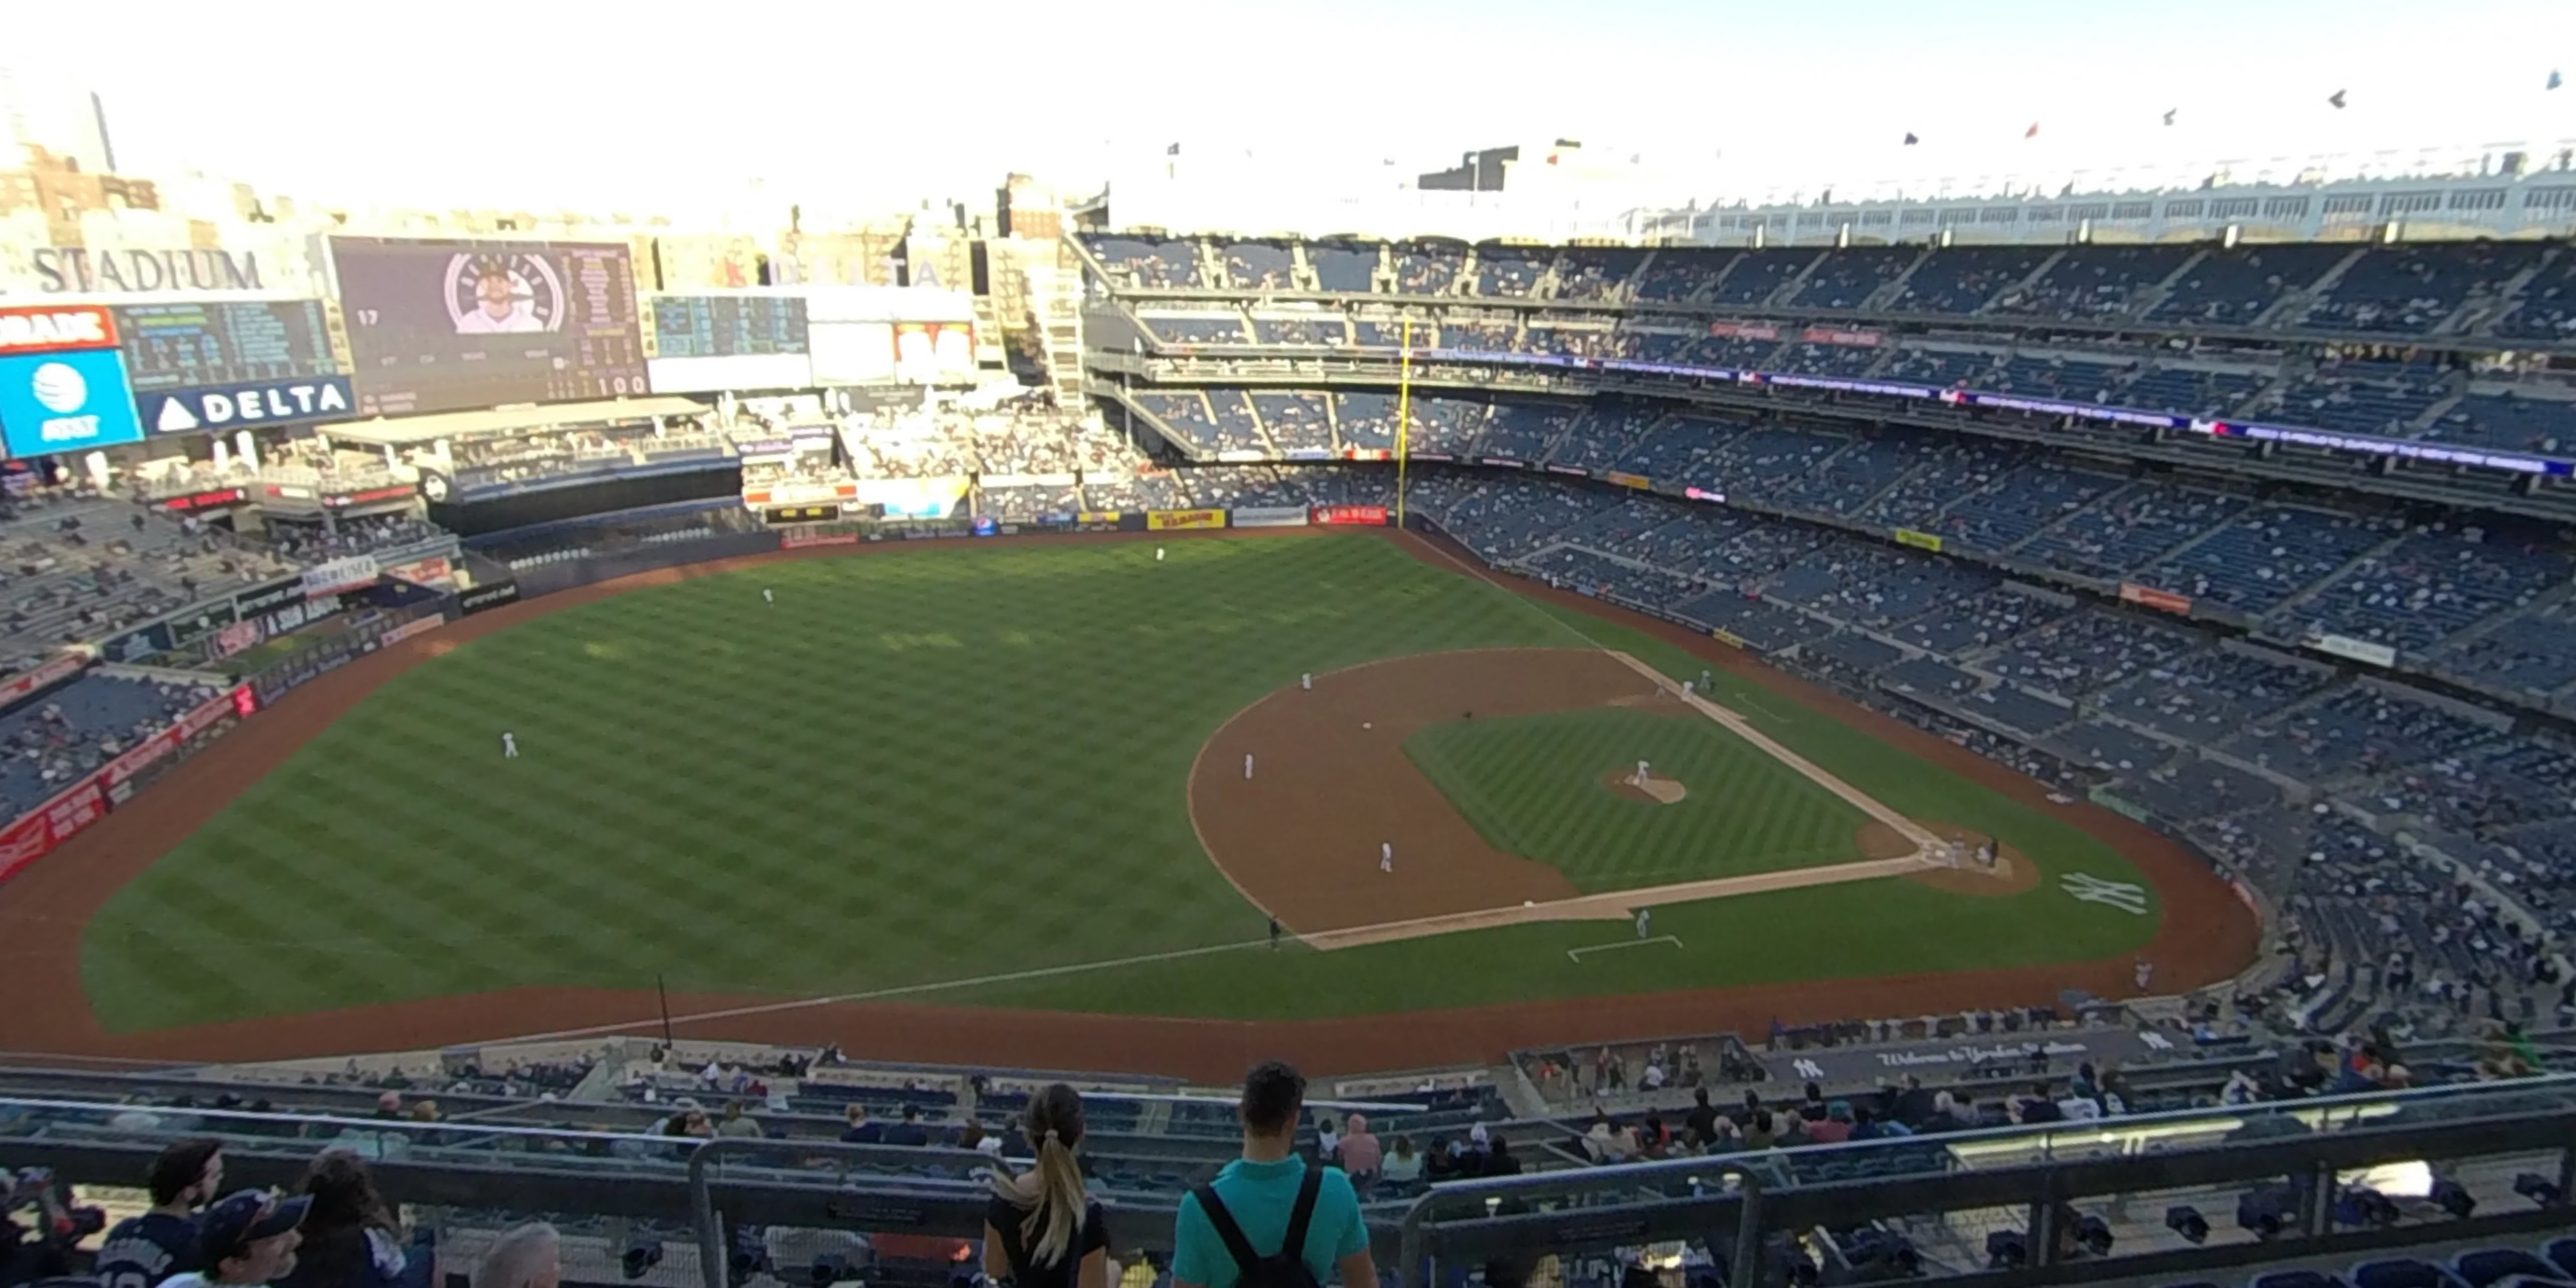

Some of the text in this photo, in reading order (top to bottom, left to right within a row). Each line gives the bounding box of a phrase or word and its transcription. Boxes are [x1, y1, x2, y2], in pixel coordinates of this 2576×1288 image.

[33, 248, 264, 293] STADIUM
[766, 255, 942, 288] DTA
[357, 310, 378, 325] 17
[202, 383, 346, 423] DELTA
